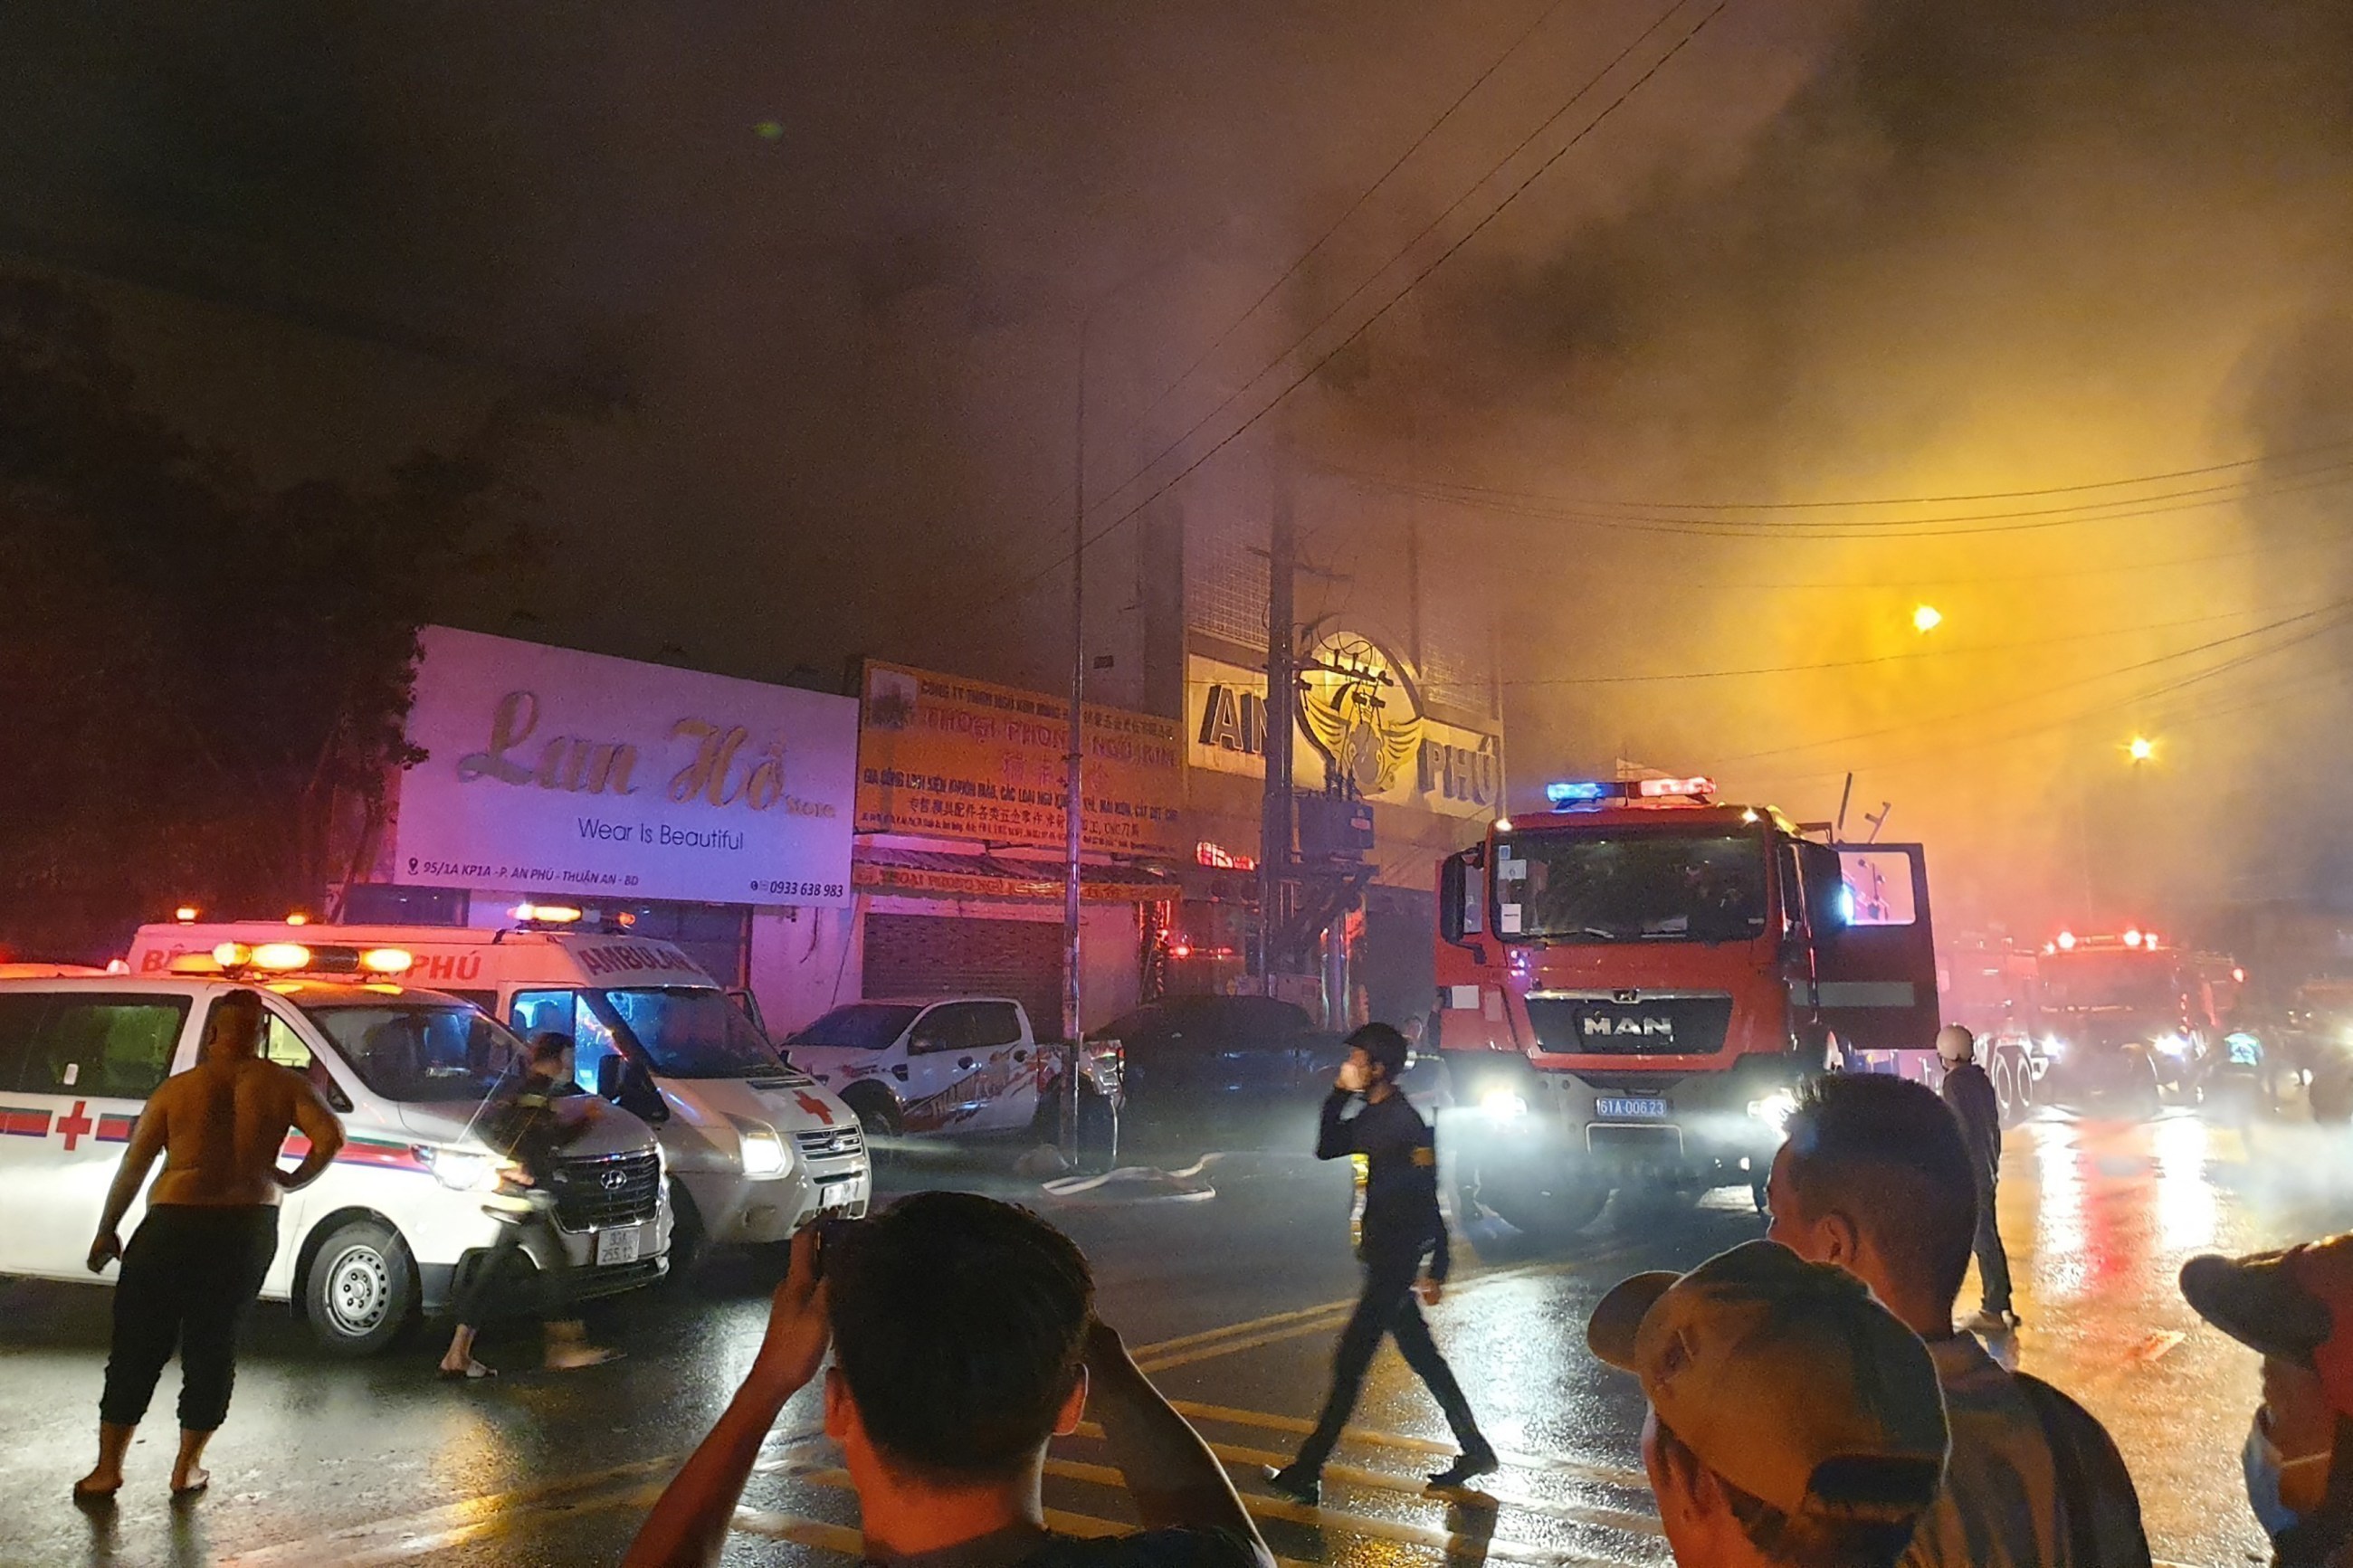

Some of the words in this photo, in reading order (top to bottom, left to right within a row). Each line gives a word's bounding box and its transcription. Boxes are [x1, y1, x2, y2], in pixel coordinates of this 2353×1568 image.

[459, 691, 639, 795] Lan
[1417, 736, 1499, 806] PHÚ
[578, 818, 633, 841] Wear
[640, 823, 653, 843] Is
[660, 824, 744, 850] Beautiful
[424, 861, 459, 875] 95/1A
[462, 864, 491, 877] KP1A
[510, 867, 529, 879] AN
[530, 867, 554, 880] PHÚ
[600, 873, 616, 885] AN
[770, 881, 797, 895] 0933
[800, 882, 821, 896] 638
[824, 884, 843, 898] 983
[405, 950, 481, 980] PHÚ
[1584, 1017, 1672, 1035] MAN
